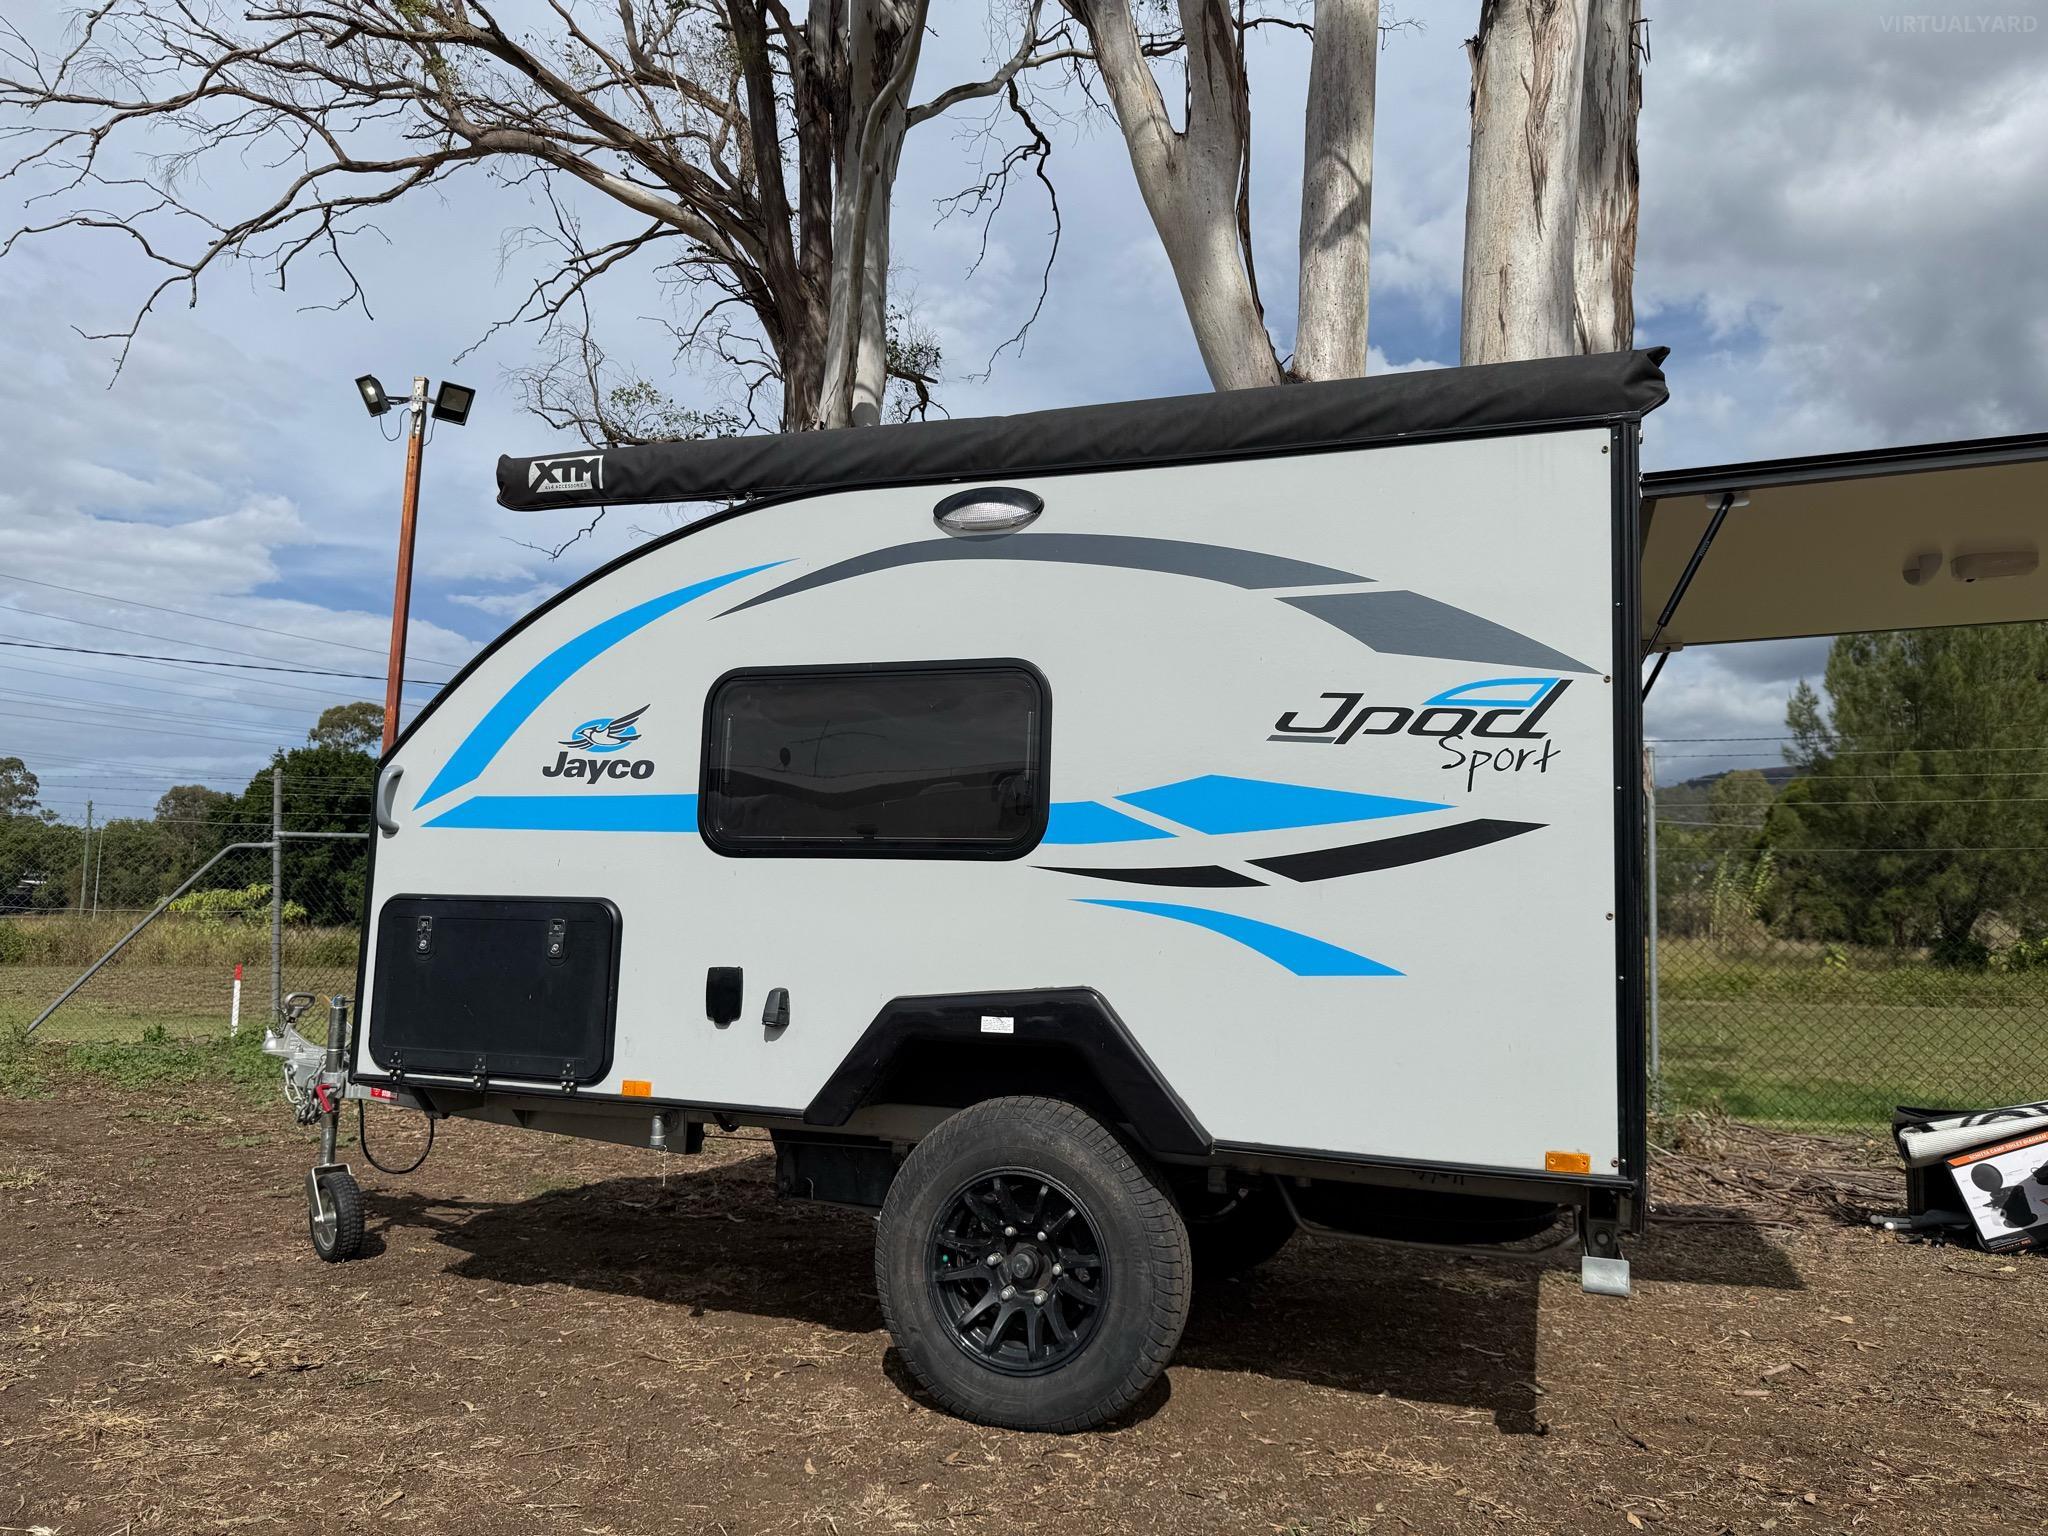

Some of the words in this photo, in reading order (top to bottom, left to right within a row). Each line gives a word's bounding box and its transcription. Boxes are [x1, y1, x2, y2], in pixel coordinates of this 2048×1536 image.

[529, 457, 602, 492] XTM
[1267, 678, 1574, 745] Jpod
[542, 751, 655, 784] Jayco
[1438, 735, 1561, 792] Sport
